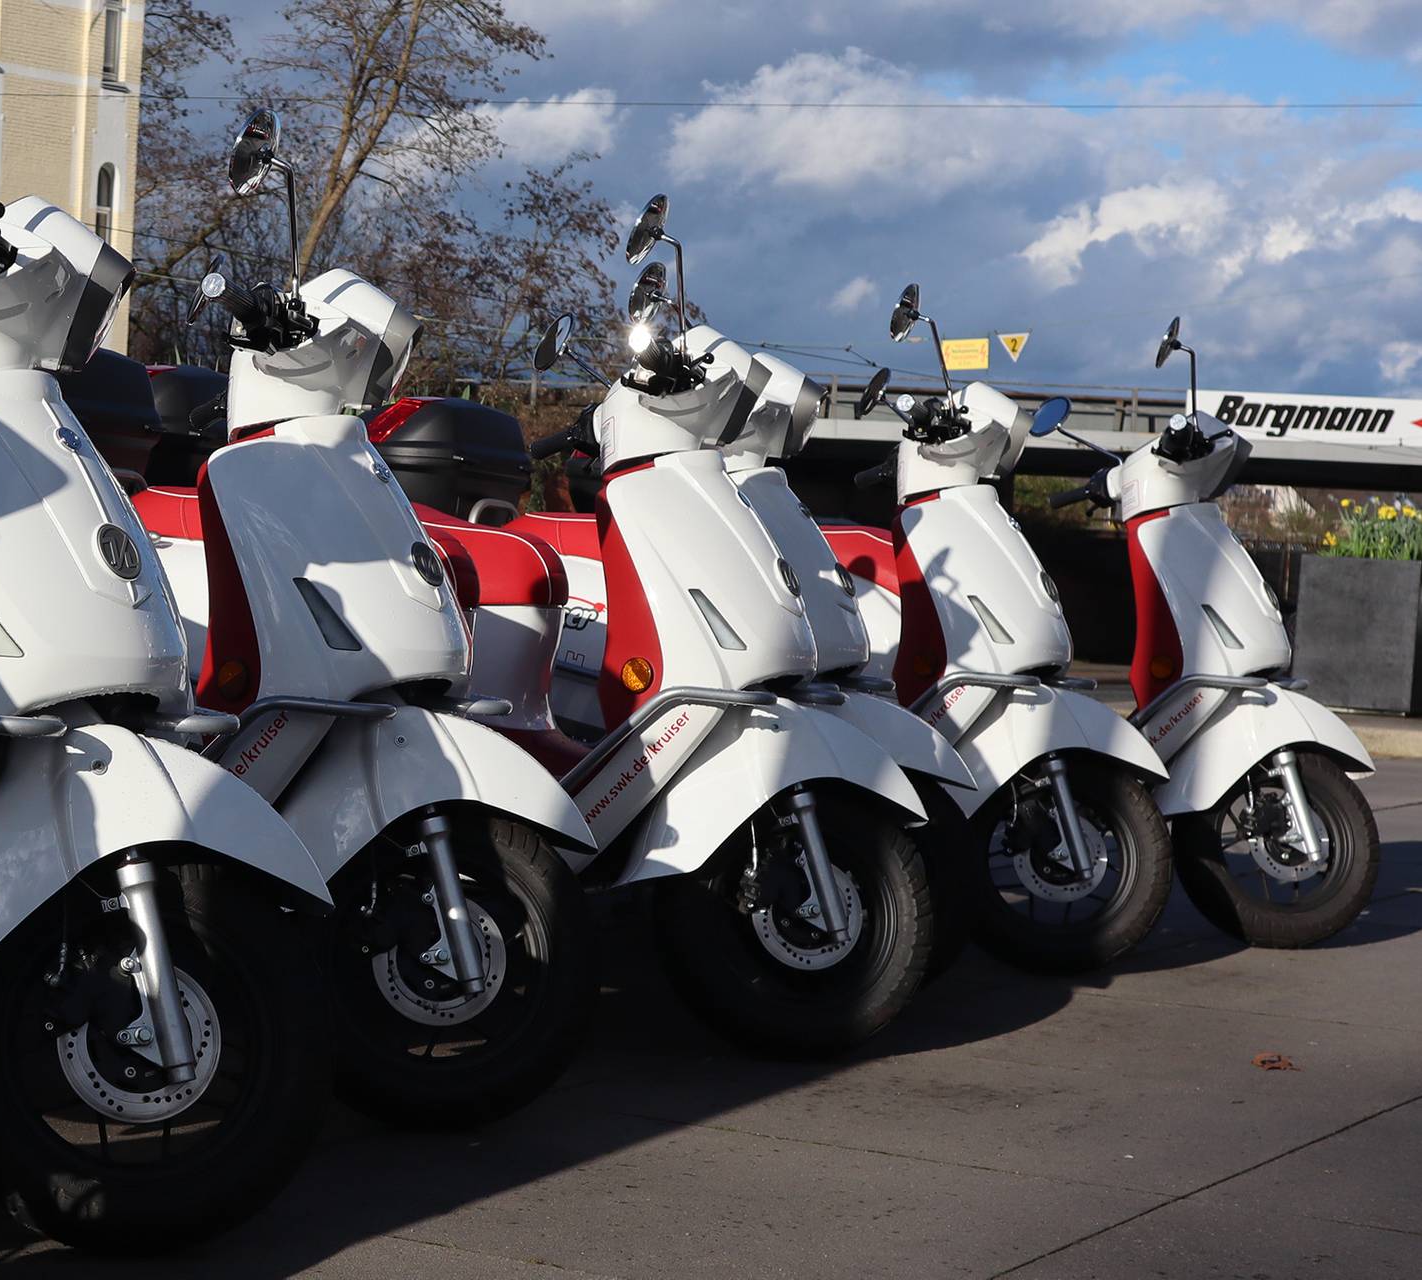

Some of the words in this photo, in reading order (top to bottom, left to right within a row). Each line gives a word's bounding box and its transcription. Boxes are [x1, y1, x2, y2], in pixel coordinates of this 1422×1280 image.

[1011, 338, 1018, 353] 2
[1215, 395, 1395, 437] Borgmann
[228, 710, 290, 778] e/kruiser
[1147, 691, 1204, 748] k.de/kruiser
